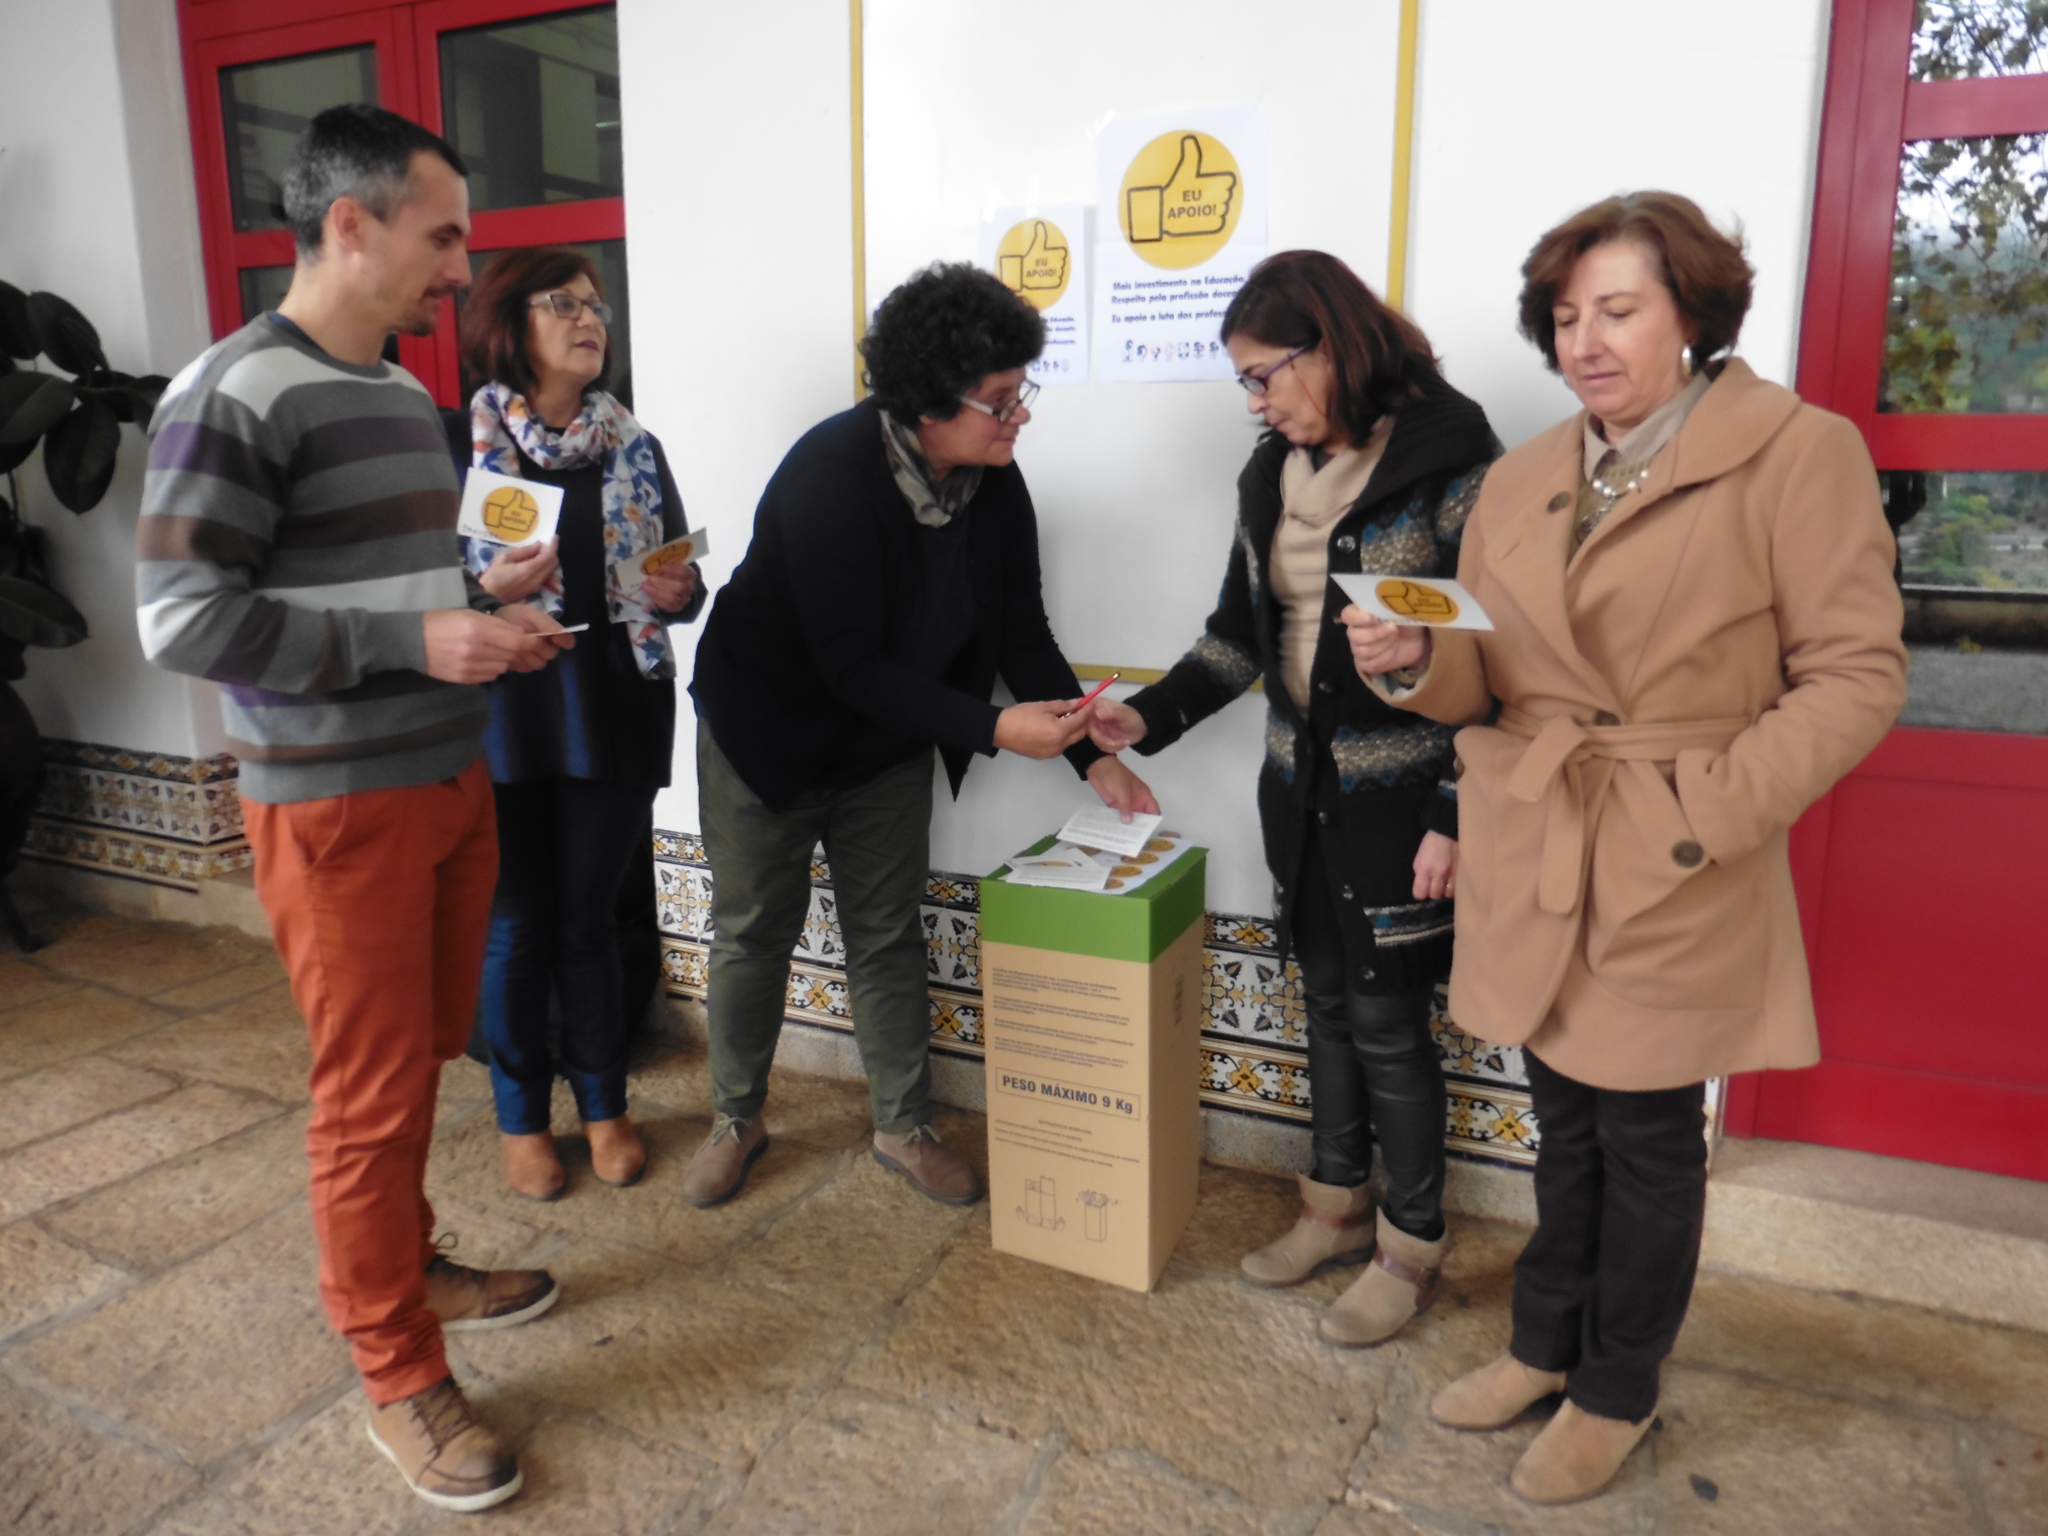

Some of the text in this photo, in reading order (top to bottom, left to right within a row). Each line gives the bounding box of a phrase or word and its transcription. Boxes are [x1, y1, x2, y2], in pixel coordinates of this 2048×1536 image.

[1182, 189, 1202, 202] EU
[1167, 204, 1216, 219] APOIO!
[1035, 258, 1048, 267] EU
[1026, 269, 1057, 278] APOIO!
[1113, 282, 1131, 291] Mais
[1135, 279, 1187, 290] investimento
[1111, 295, 1146, 305] Respeito
[1149, 293, 1167, 304] pela
[1169, 291, 1209, 302] profissão
[1112, 314, 1121, 323] Eu
[1124, 314, 1147, 324] apoio
[1158, 312, 1174, 321] luta
[1177, 311, 1192, 320] dos
[1002, 1075, 1133, 1115] PESO MÁXIMO 9 Kg
